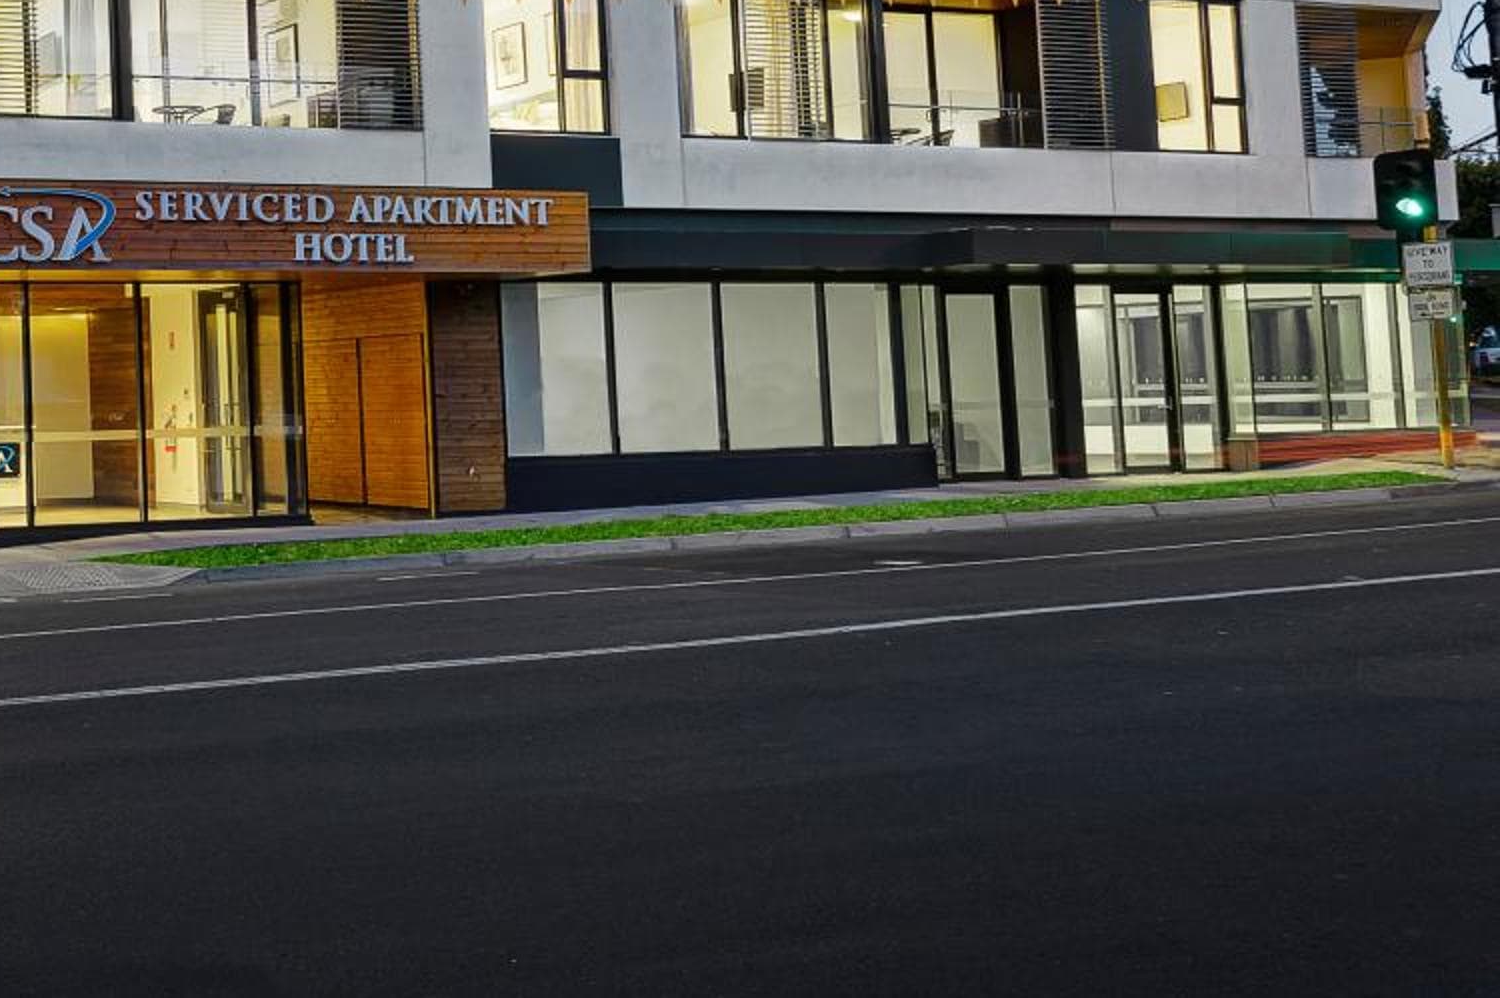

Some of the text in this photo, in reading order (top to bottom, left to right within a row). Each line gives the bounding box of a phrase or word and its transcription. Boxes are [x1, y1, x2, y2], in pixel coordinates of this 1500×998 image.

[135, 191, 553, 226] SERVICED APARTMENT
[294, 233, 414, 263] HOTEL
[1422, 259, 1435, 269] TO
